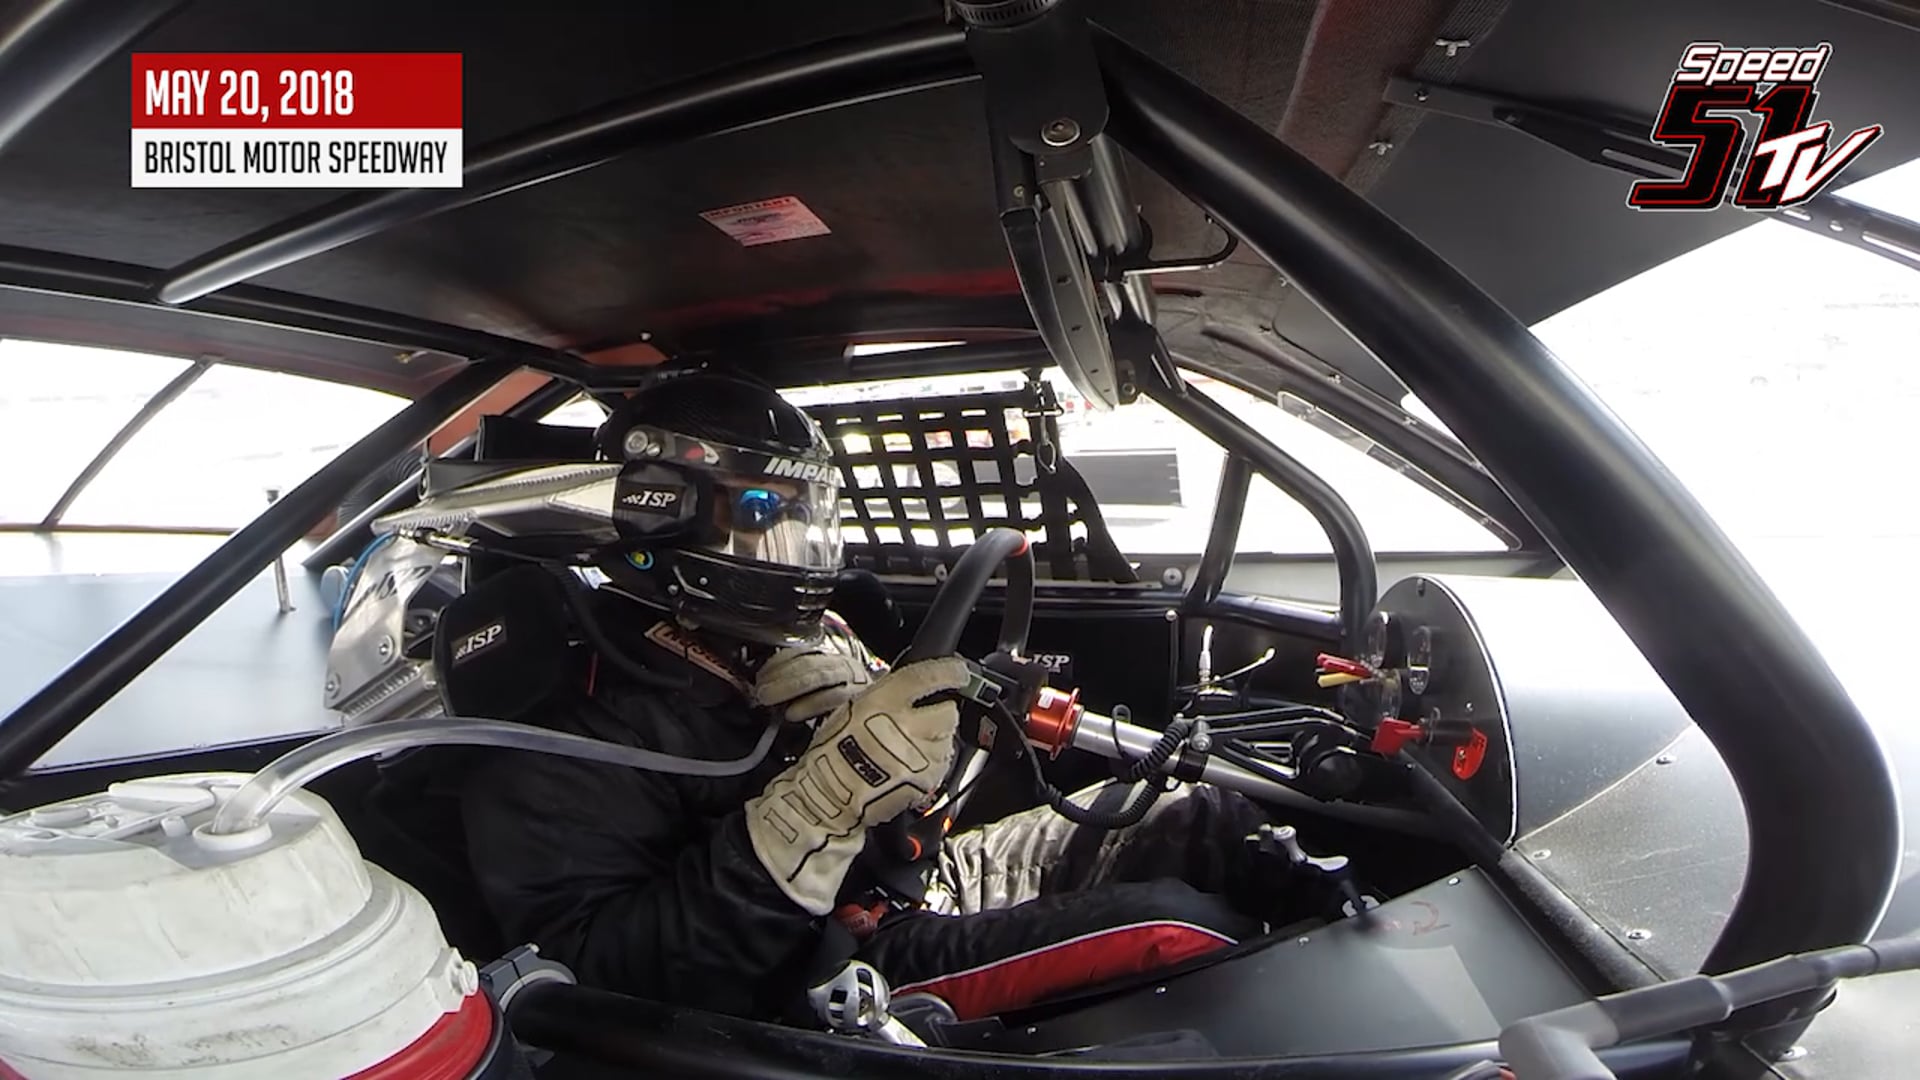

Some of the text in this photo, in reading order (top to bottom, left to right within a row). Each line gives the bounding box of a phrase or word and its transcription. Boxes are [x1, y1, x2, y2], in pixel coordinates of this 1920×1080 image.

[638, 489, 676, 508] ISP
[465, 624, 502, 654] ISP
[1032, 653, 1070, 669] ISP
